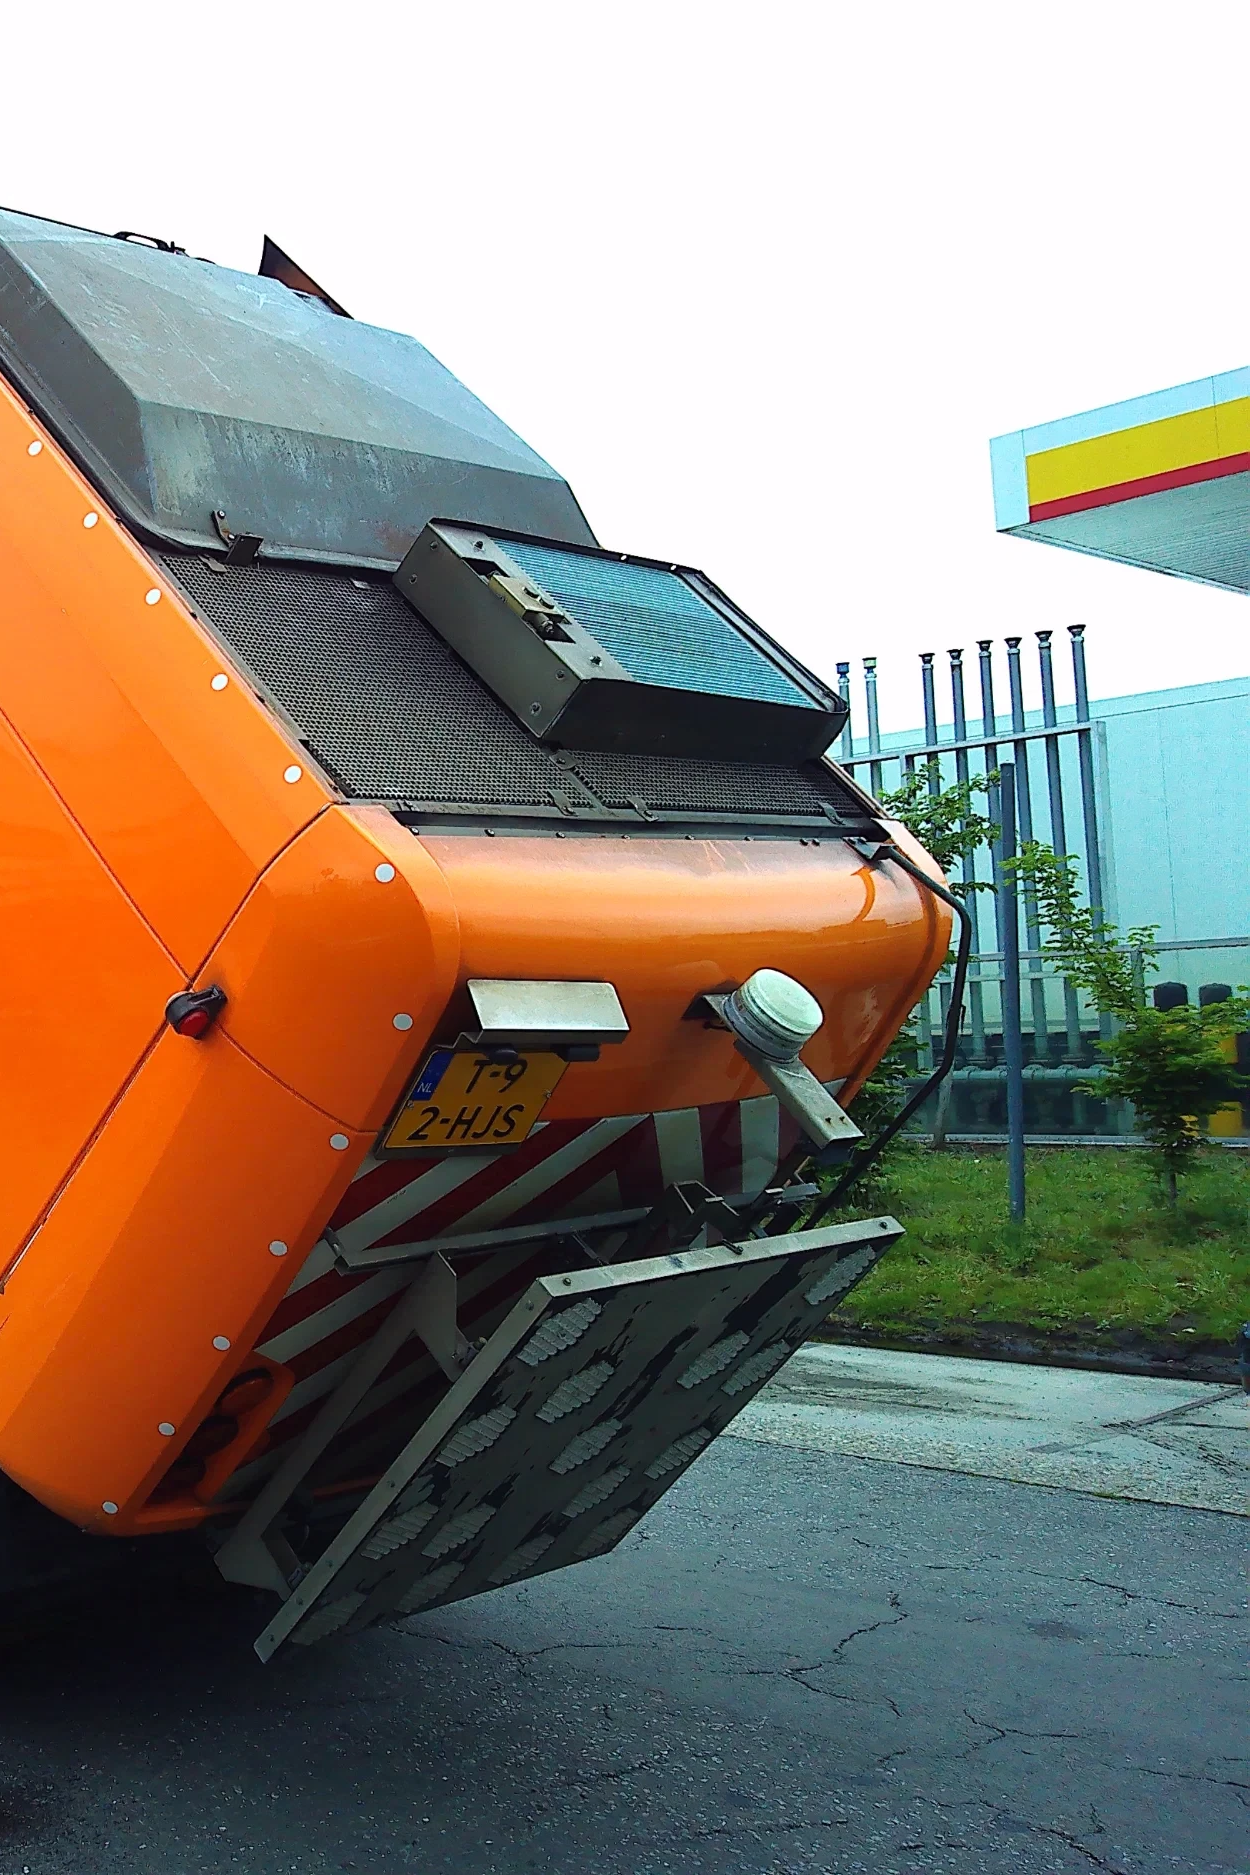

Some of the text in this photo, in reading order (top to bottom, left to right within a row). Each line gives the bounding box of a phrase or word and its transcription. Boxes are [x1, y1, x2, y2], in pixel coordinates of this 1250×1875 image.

[417, 1082, 432, 1093] NL
[465, 1059, 528, 1094] T-9
[406, 1104, 525, 1141] 2-HJS
